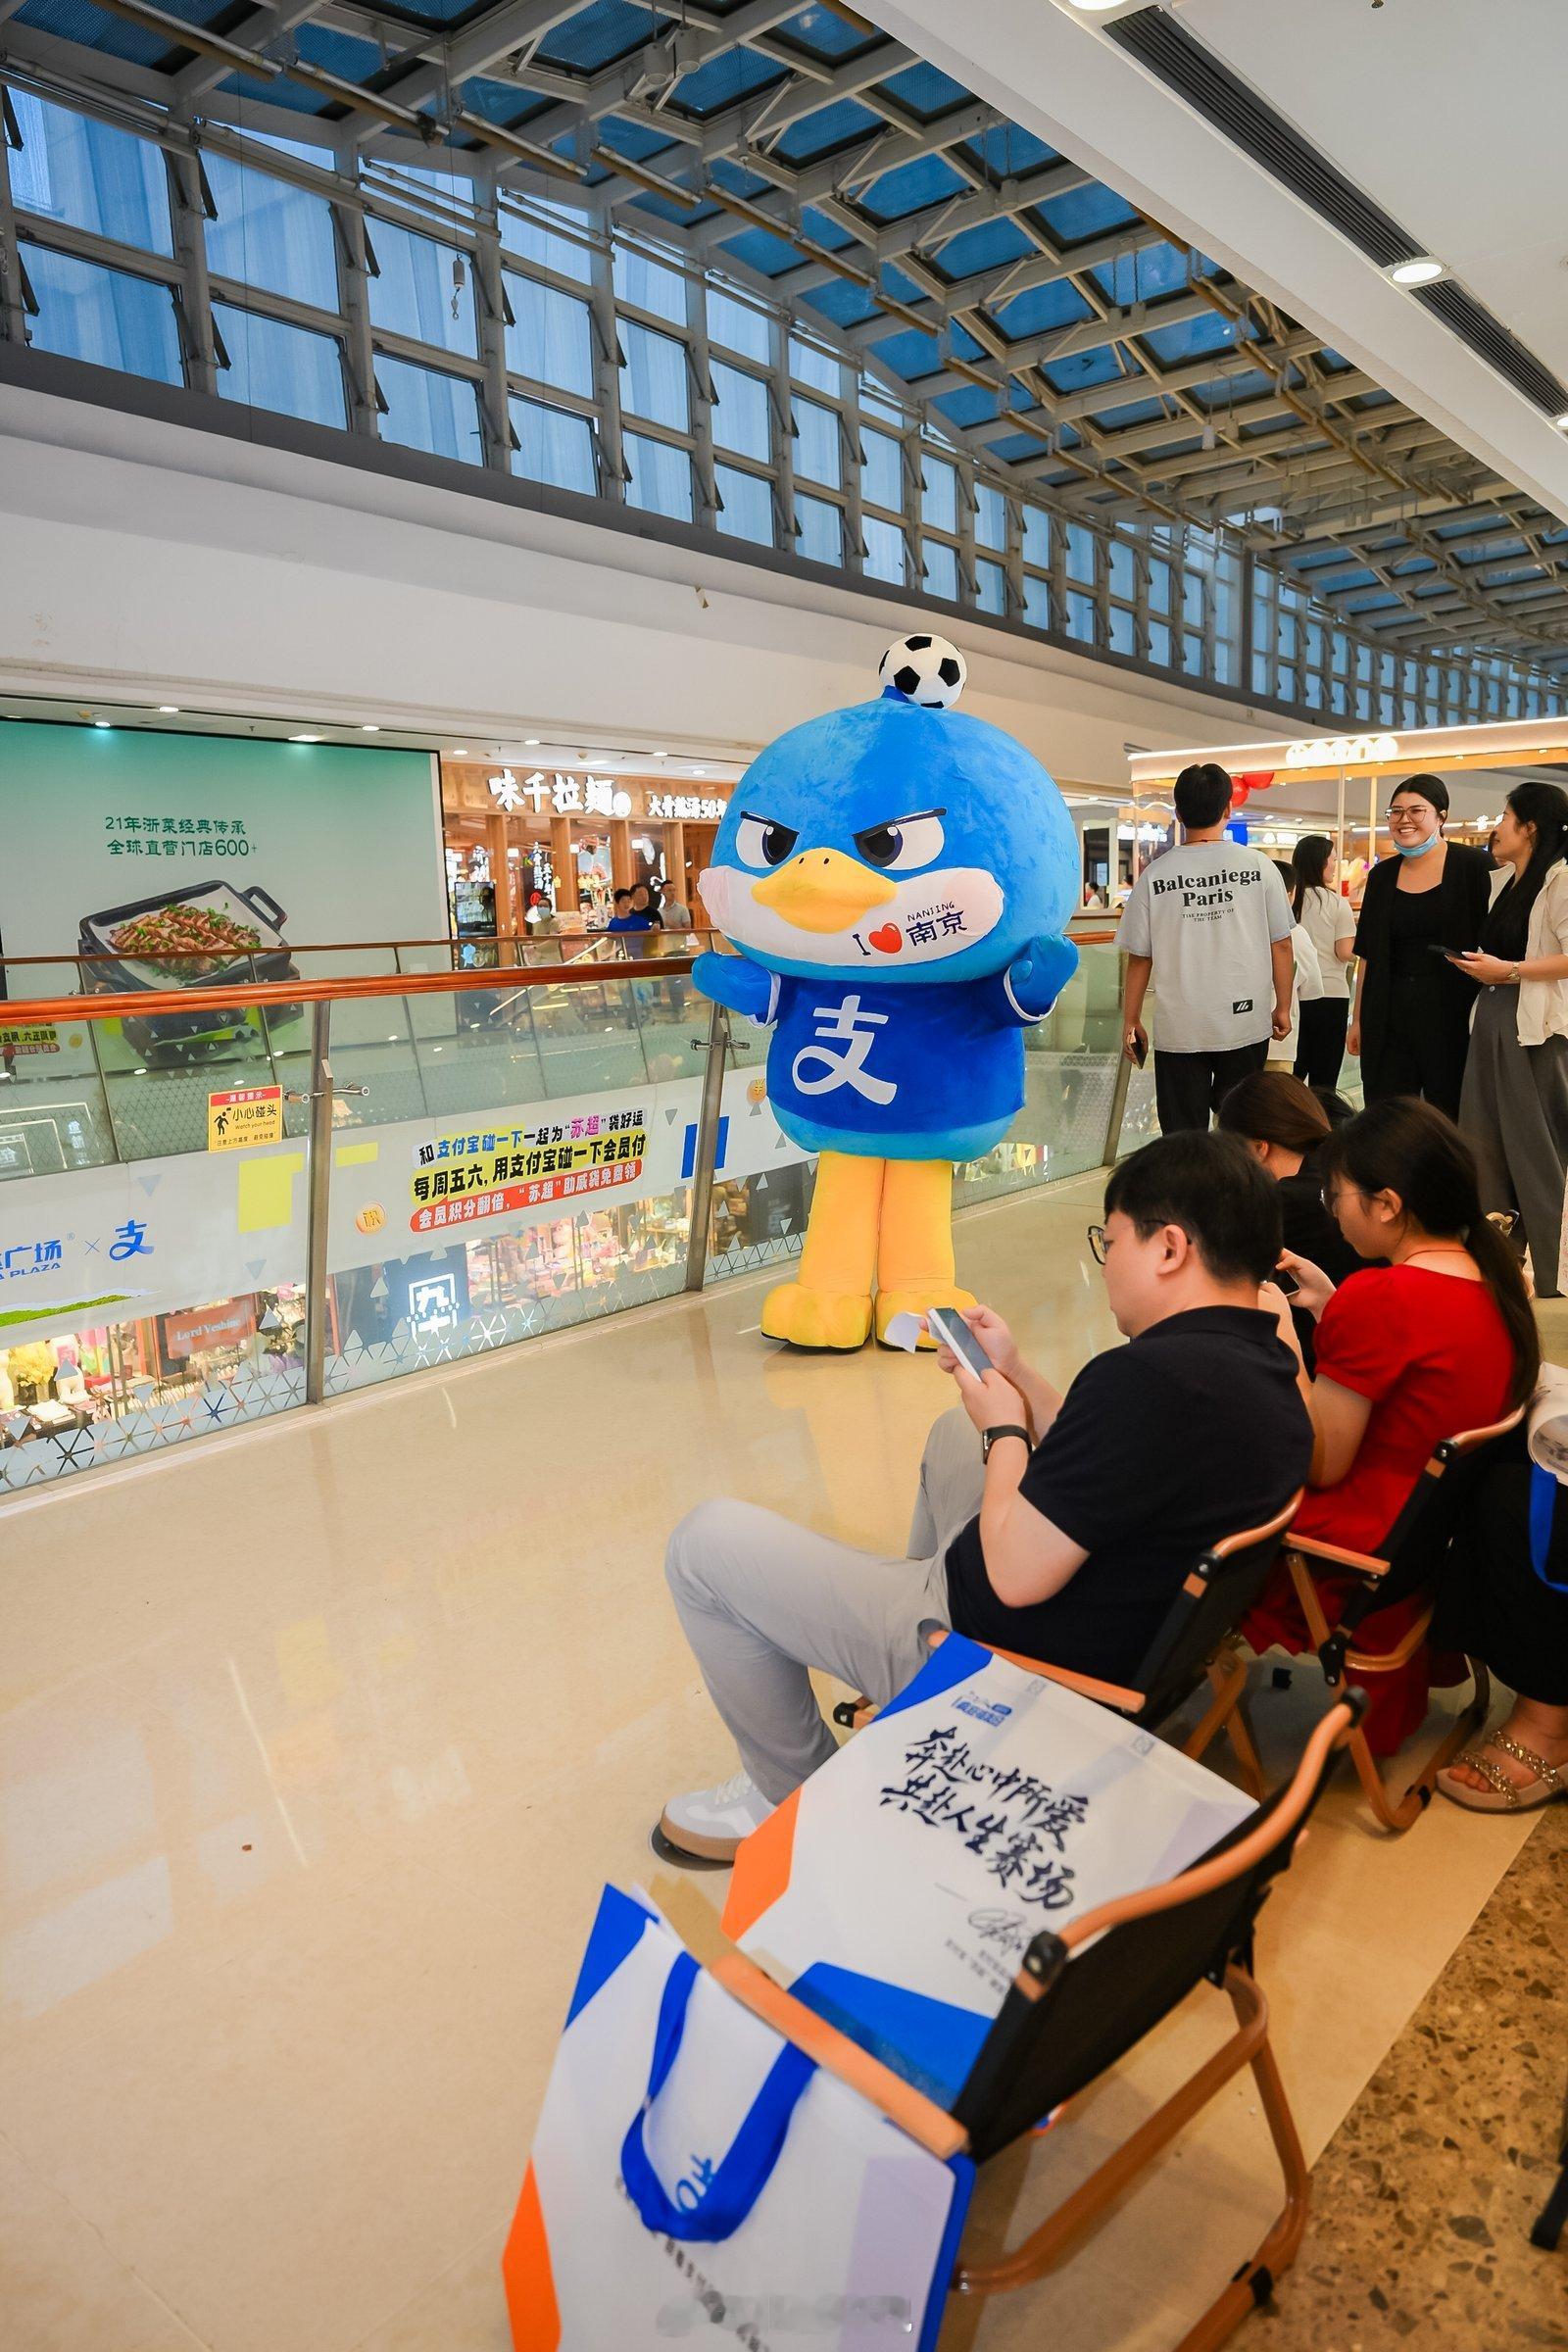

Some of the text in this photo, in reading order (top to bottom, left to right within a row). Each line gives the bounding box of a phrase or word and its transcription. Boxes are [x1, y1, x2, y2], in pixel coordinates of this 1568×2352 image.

[105, 815, 246, 835] 21年浙菜经典传承
[1152, 869, 1261, 896] Balcaniega
[907, 901, 956, 922] NANJING
[1182, 889, 1234, 907] Paris
[852, 910, 967, 956] I 南京
[792, 995, 899, 1105] 支
[232, 1103, 277, 1121] 小心碰头
[0, 1239, 62, 1270] 广场
[109, 1219, 155, 1261] 支
[10, 1262, 62, 1278] PLAZA
[905, 1727, 1089, 1852] 奔赴心中所爱
[880, 1775, 1075, 1909] 共赴人生赛场
